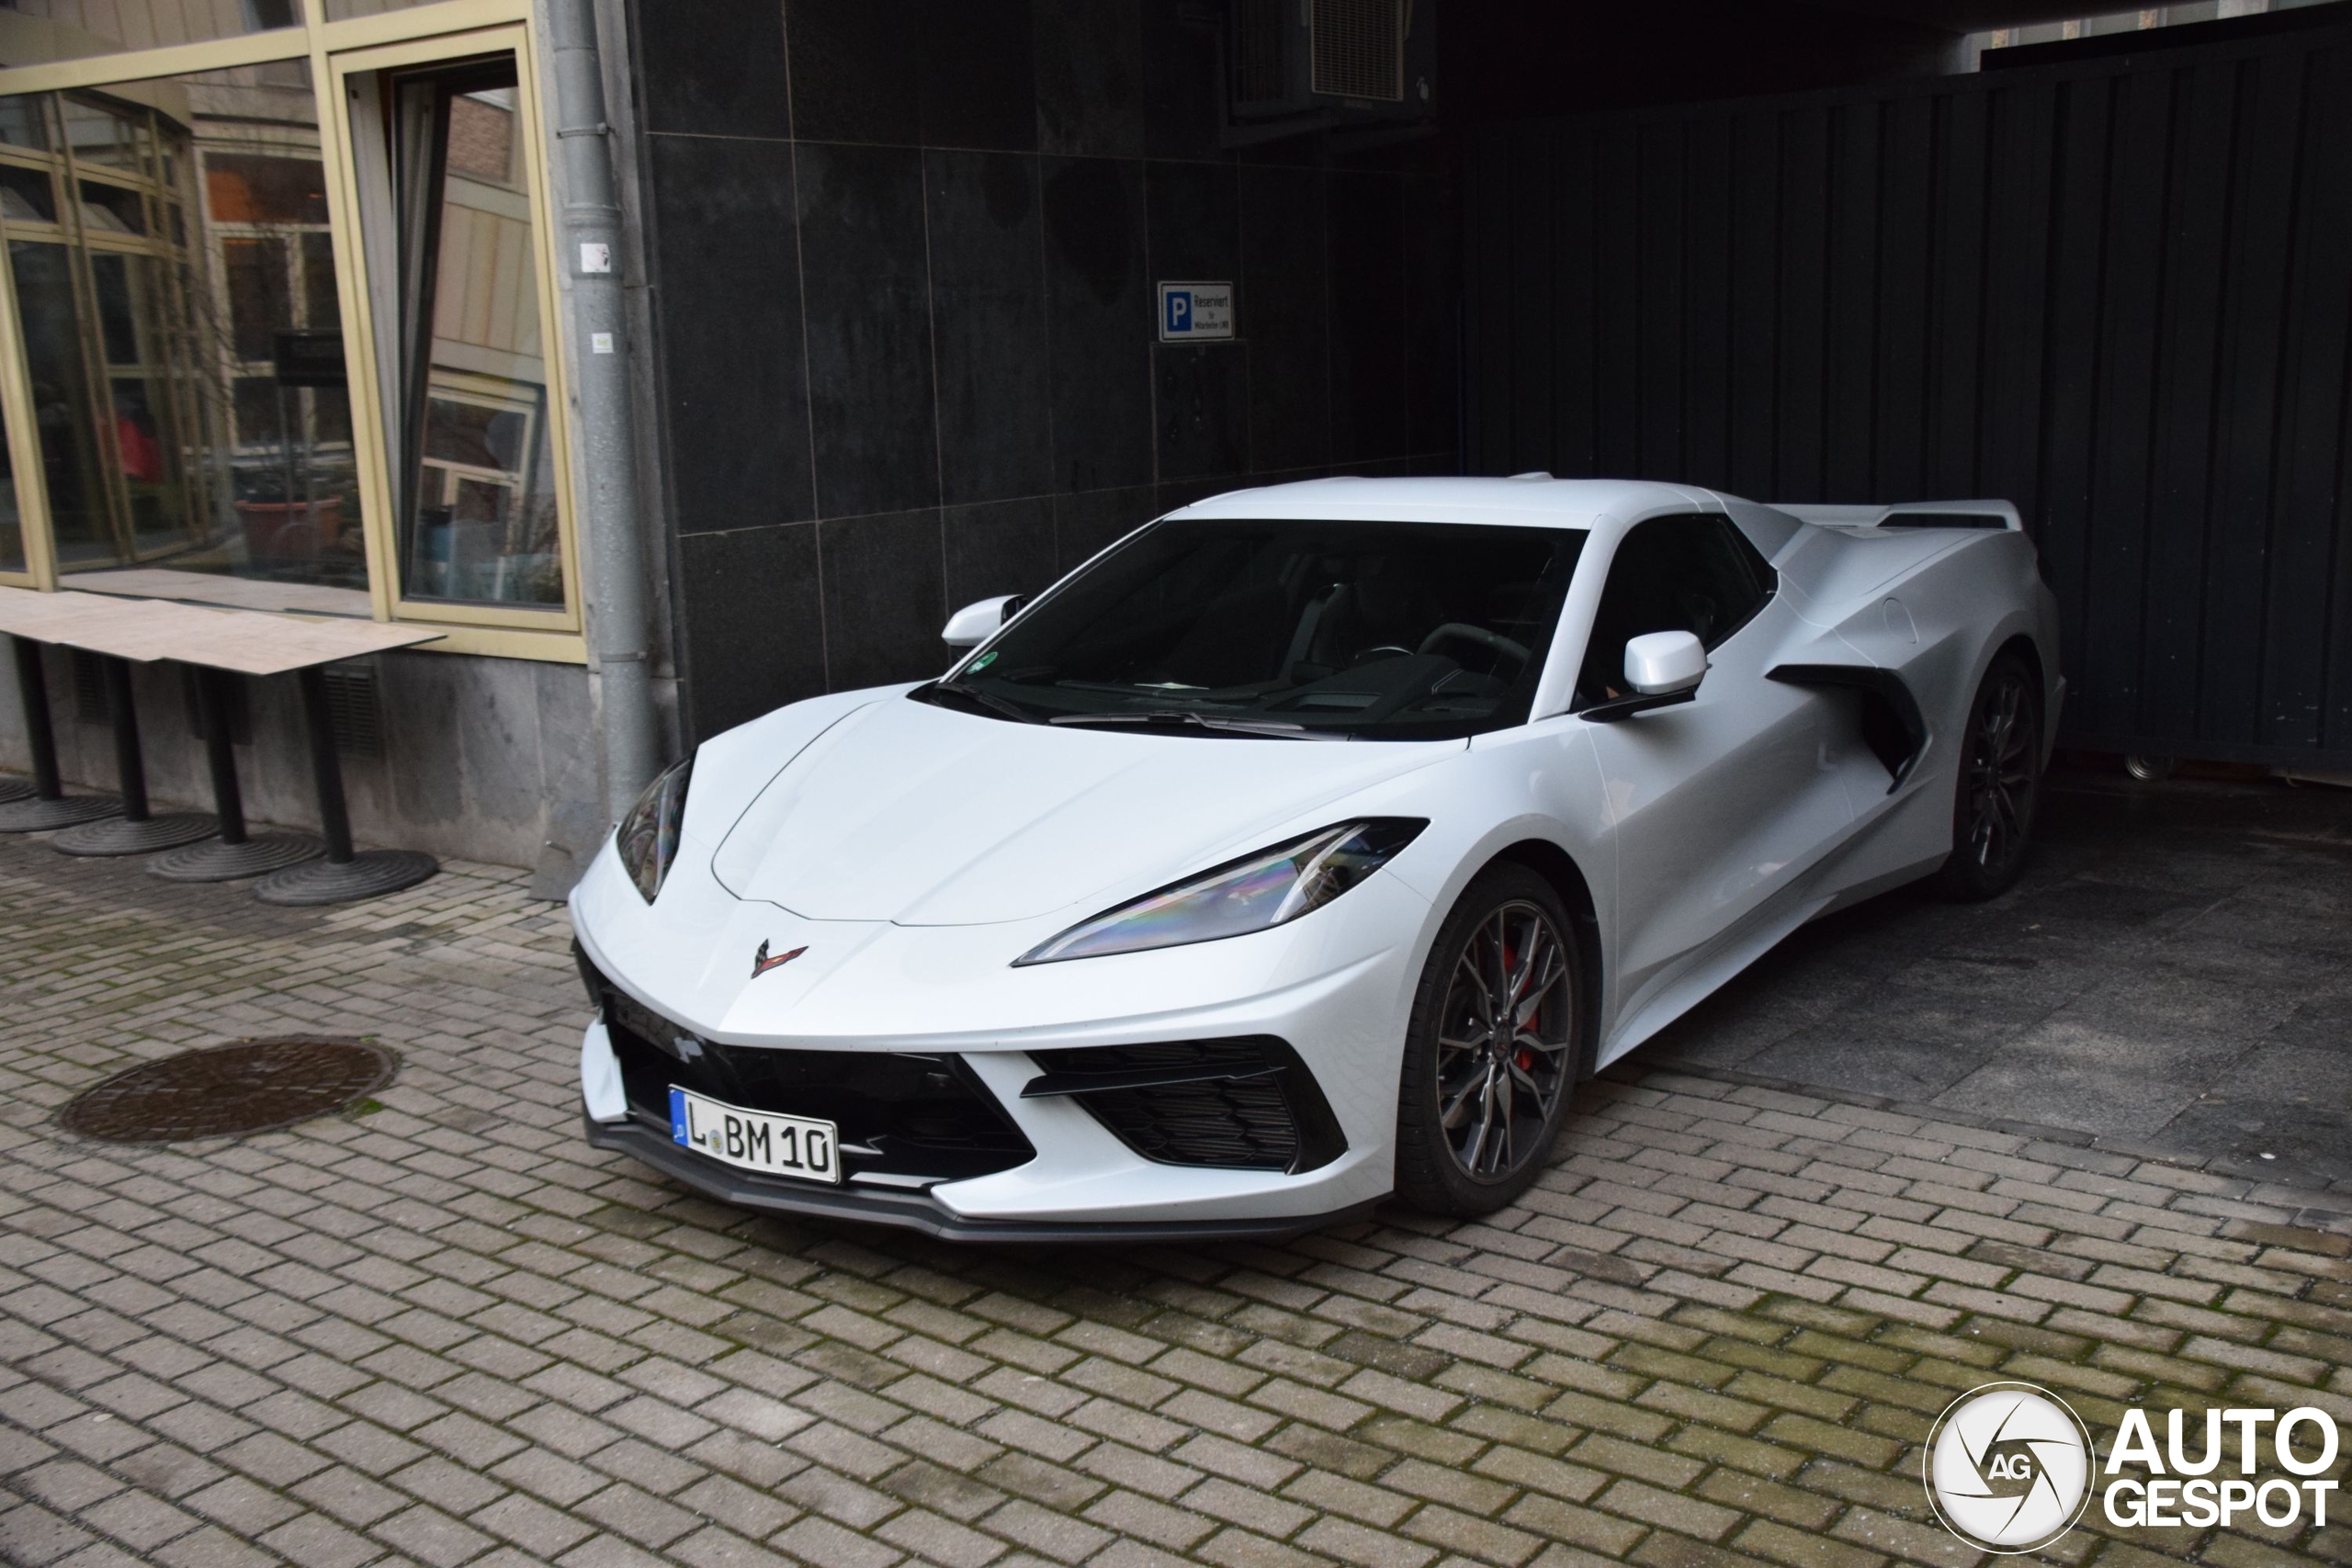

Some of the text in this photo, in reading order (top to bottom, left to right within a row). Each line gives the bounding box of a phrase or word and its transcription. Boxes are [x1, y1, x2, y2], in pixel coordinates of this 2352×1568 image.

[1172, 298, 1187, 326] P
[1194, 295, 1228, 308] Reserviert
[689, 1100, 830, 1173] L BM 10
